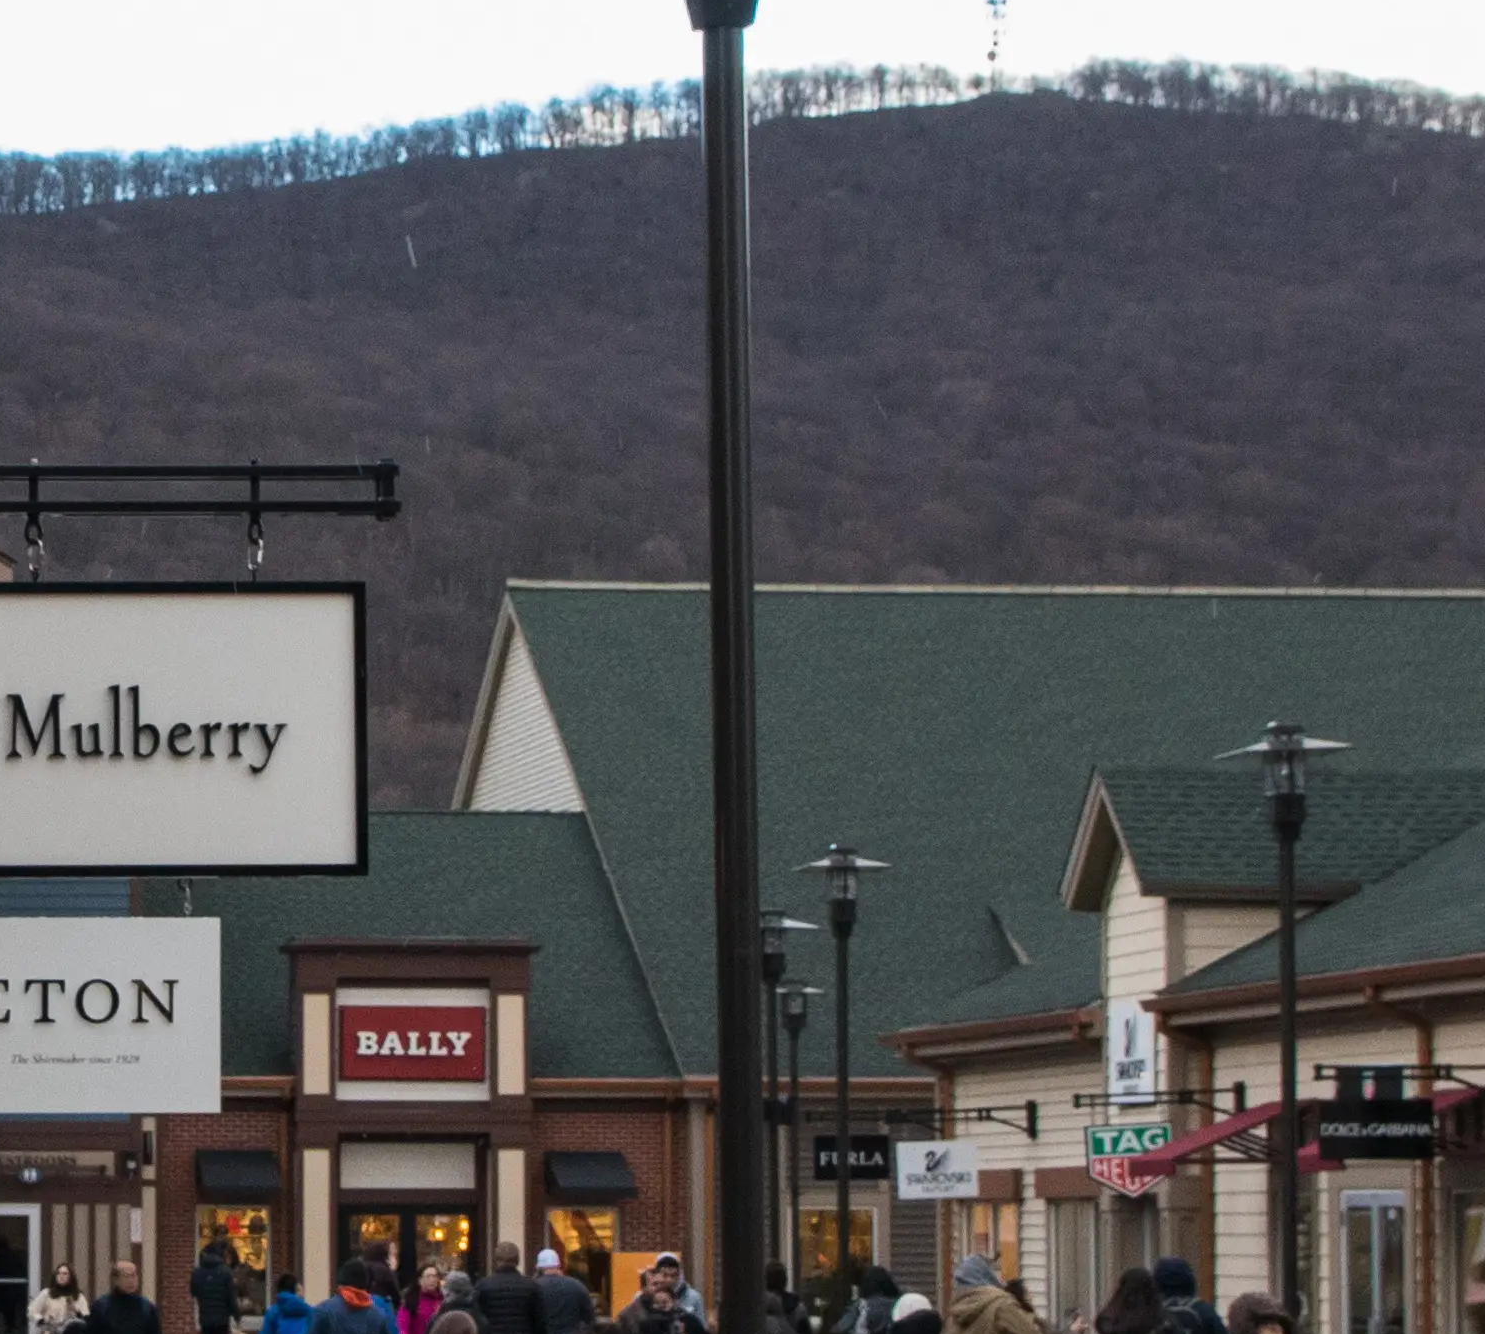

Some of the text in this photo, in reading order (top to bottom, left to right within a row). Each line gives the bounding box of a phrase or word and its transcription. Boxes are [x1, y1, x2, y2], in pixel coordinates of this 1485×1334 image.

[5, 683, 289, 775] Mulberry
[356, 1030, 473, 1057] BALLY
[1094, 1127, 1165, 1154] TAG
